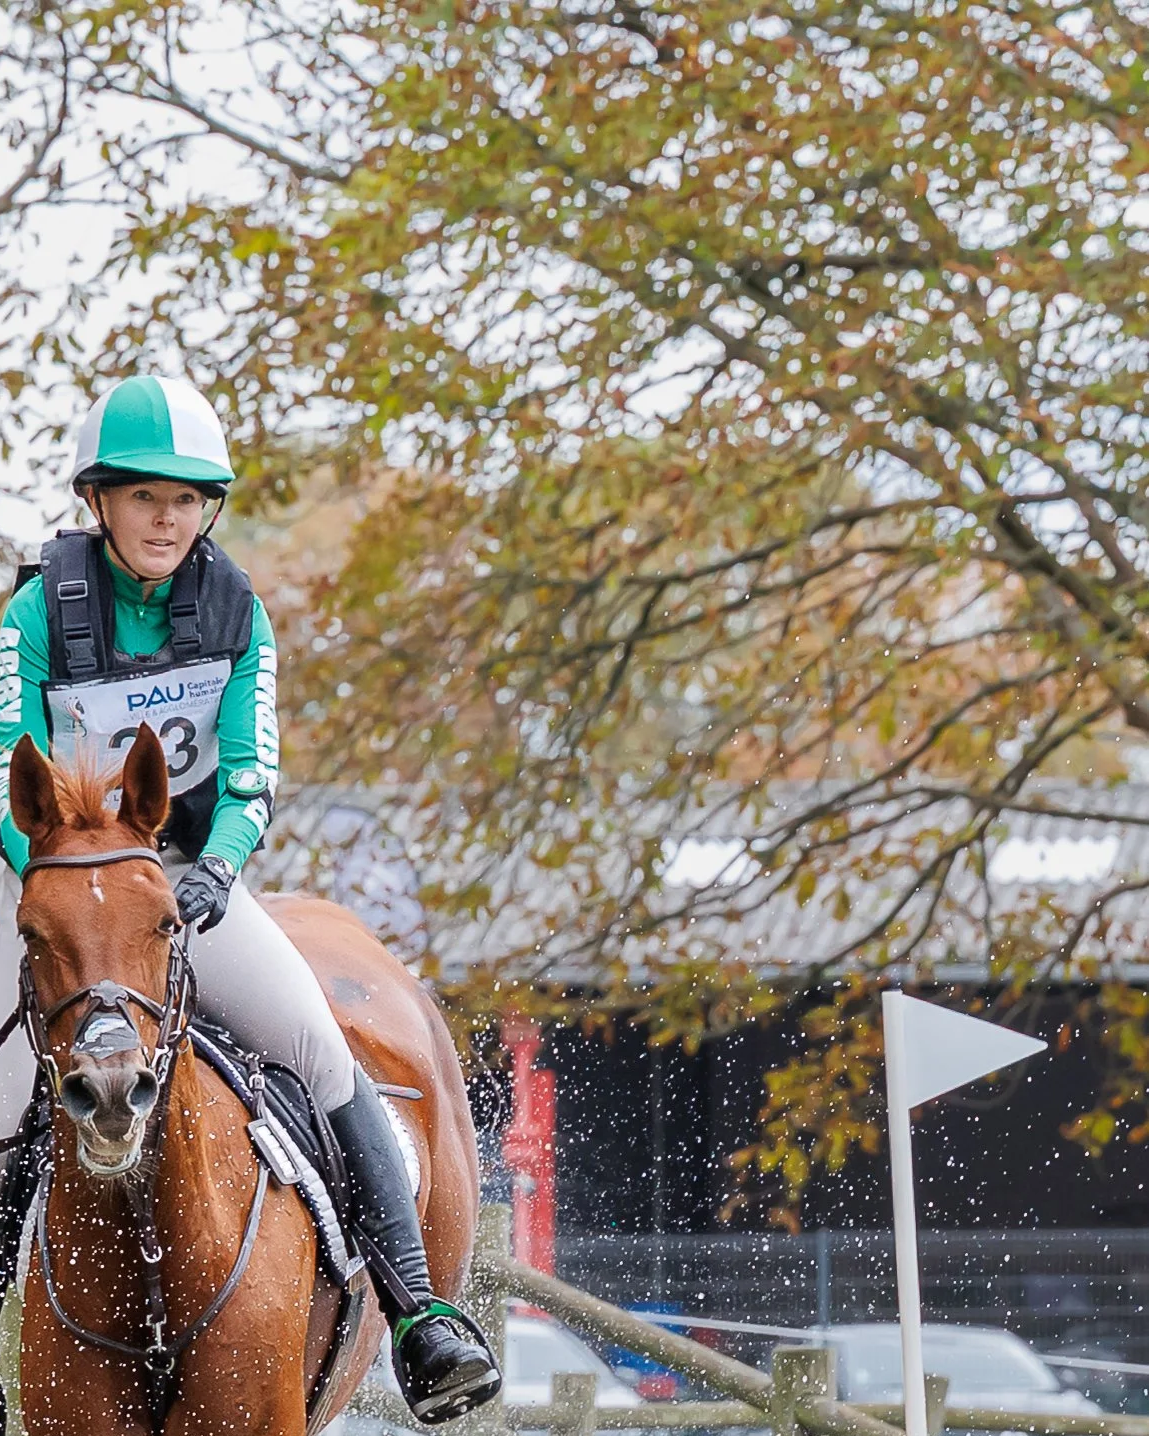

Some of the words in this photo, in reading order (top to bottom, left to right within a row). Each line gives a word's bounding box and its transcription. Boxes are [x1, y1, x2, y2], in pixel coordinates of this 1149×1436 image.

[127, 683, 184, 711] PAU
[187, 677, 224, 690] Capitale
[189, 685, 224, 698] humain
